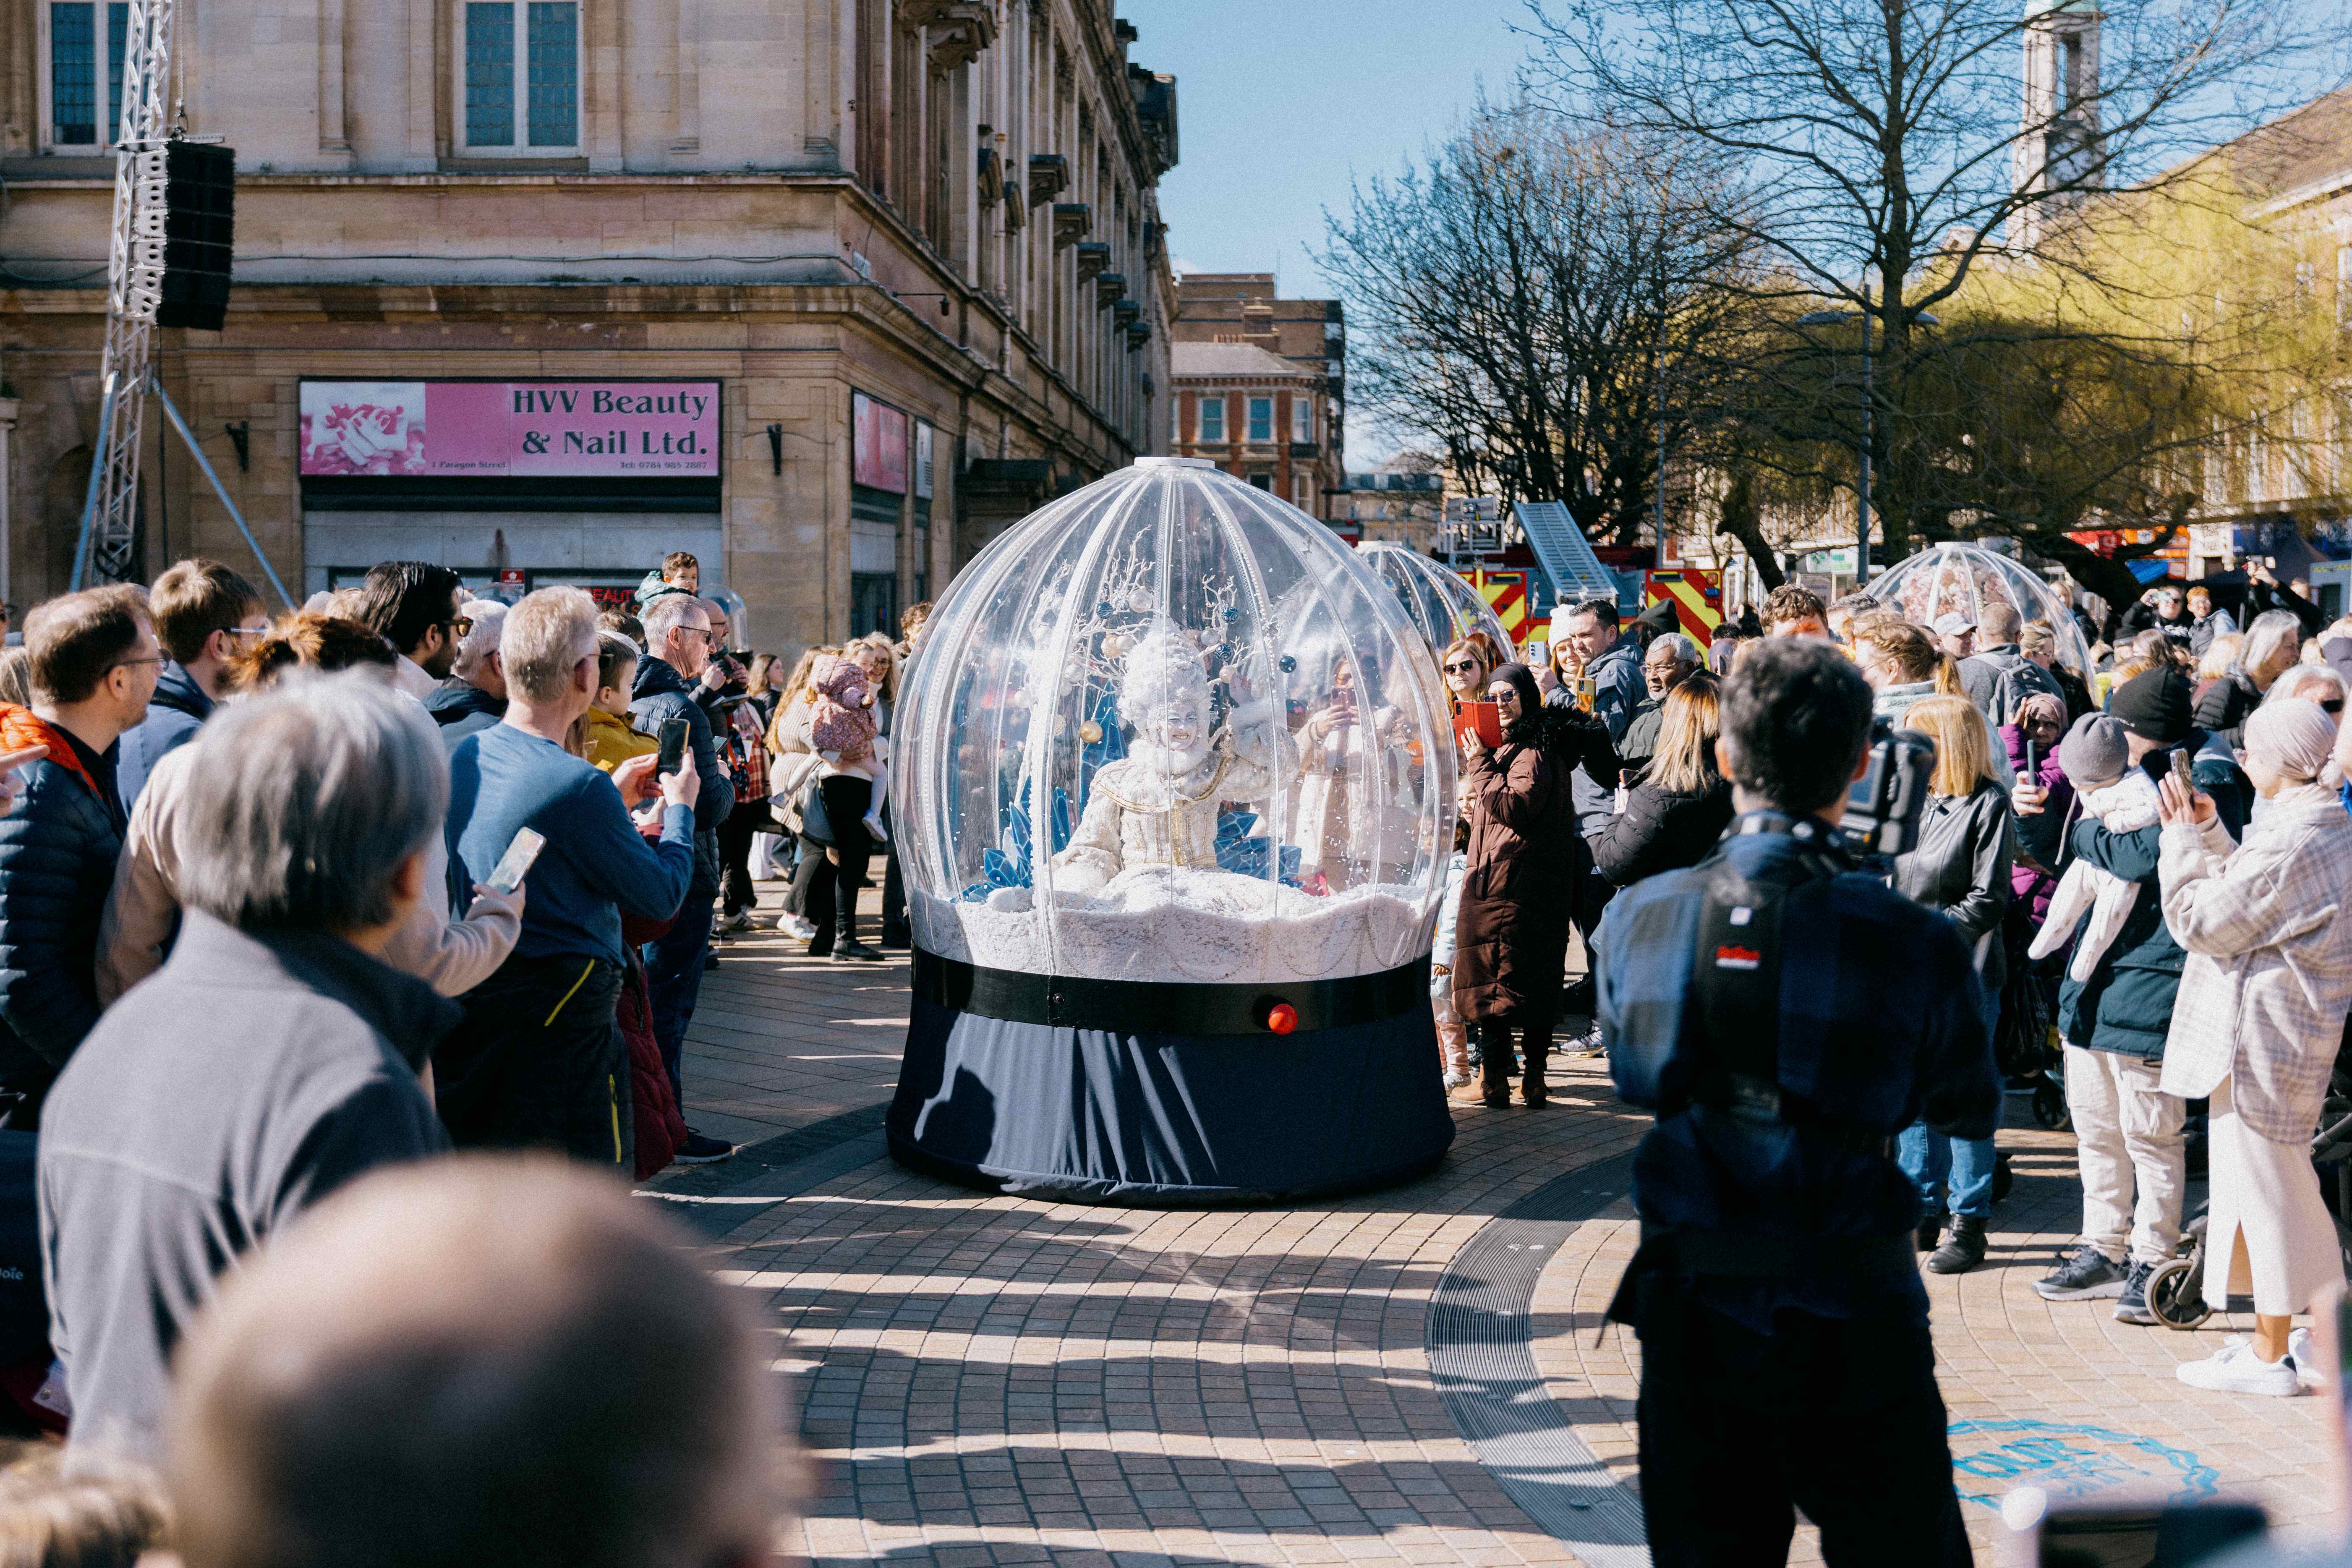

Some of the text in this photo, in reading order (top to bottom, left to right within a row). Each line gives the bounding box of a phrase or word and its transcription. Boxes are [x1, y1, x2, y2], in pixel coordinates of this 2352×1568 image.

[592, 389, 710, 420] Beauty
[522, 430, 708, 454] & Nail Ltd.
[585, 588, 636, 603] EAUT
[0, 1267, 24, 1280] oie
